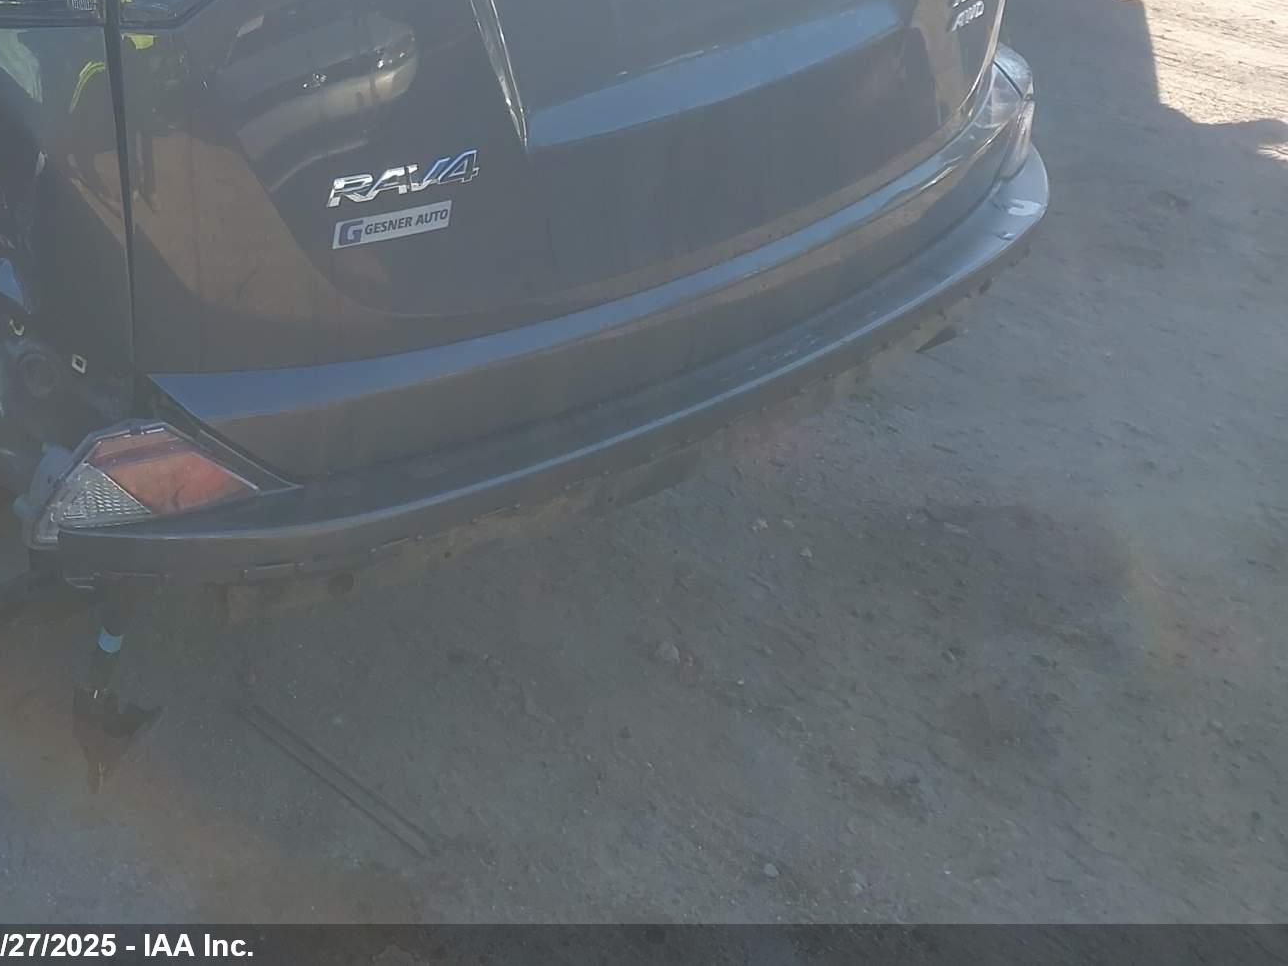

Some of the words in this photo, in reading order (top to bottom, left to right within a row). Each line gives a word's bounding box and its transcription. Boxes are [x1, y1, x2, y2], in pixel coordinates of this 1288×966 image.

[951, 0, 984, 32] AWD
[326, 149, 480, 208] RAV4
[365, 216, 413, 235] GESNER
[416, 208, 449, 226] AUTO
